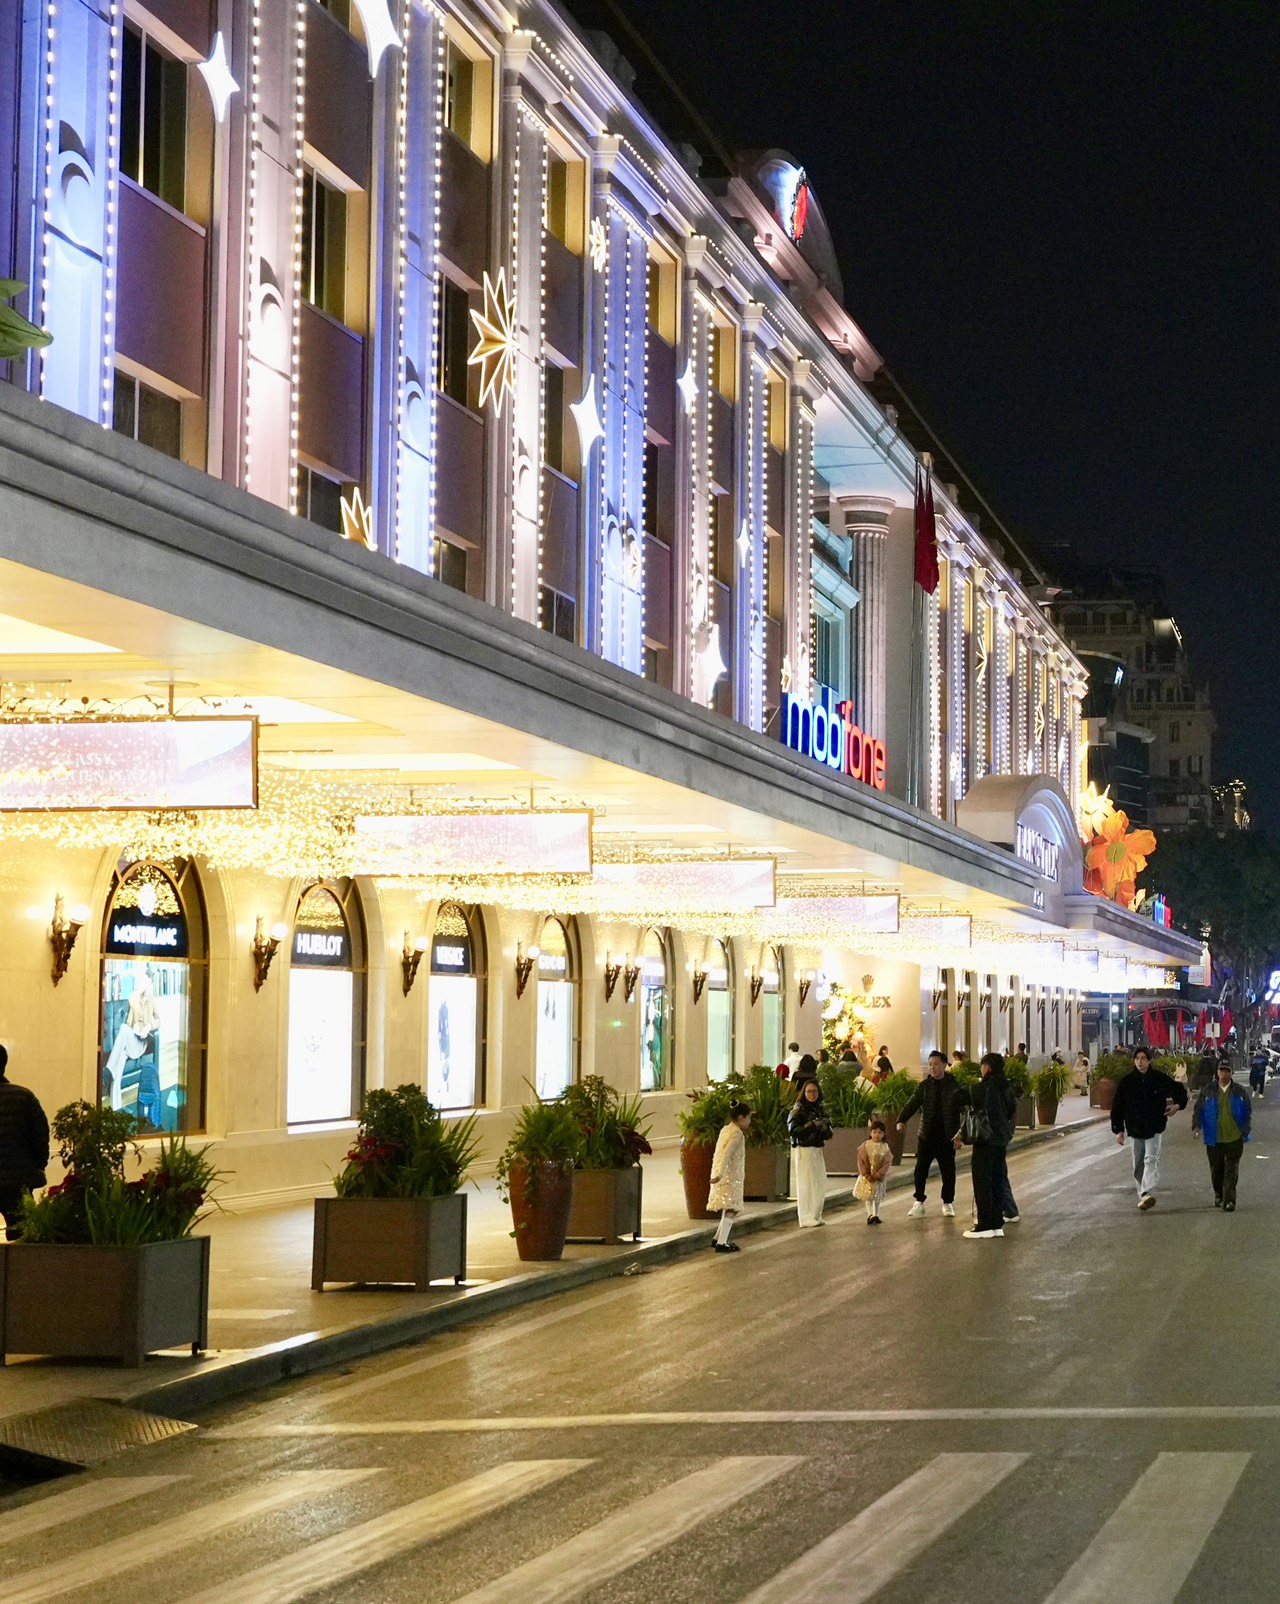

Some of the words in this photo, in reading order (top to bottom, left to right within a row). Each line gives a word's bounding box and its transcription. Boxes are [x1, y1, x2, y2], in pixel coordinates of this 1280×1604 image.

[780, 687, 886, 791] mobifone
[114, 924, 178, 946] MONTBLANC
[297, 933, 343, 956] HUBLOT
[538, 955, 566, 970] GUCCI
